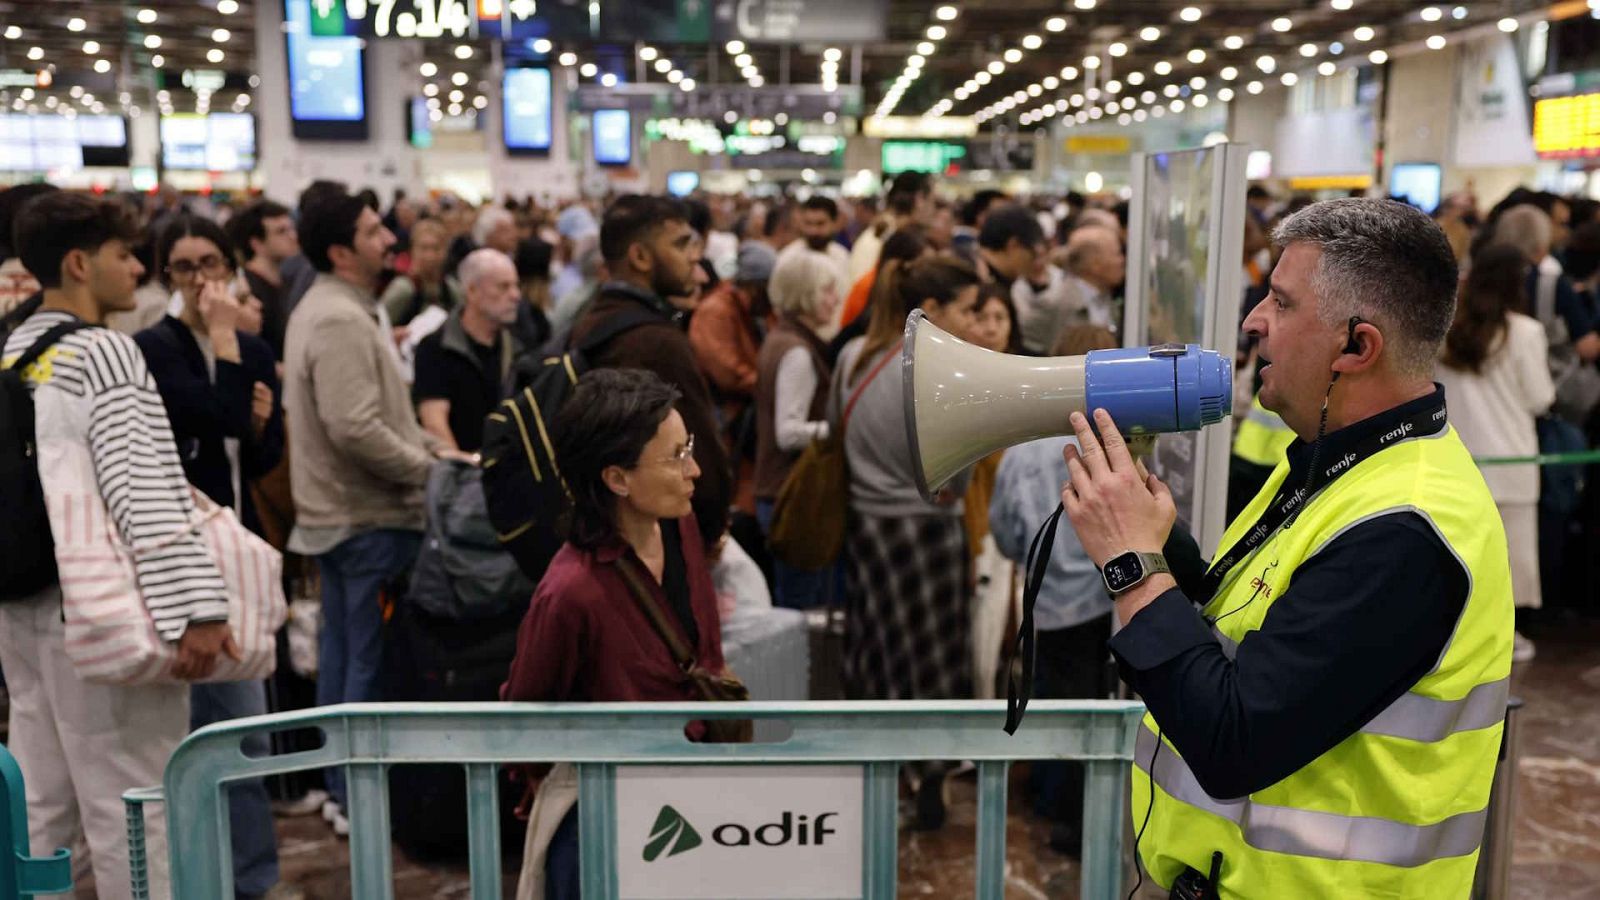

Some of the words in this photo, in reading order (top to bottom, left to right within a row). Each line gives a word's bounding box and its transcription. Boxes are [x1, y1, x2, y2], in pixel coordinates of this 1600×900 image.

[1214, 556, 1233, 577] renfe
[1245, 524, 1269, 547] renfe
[1281, 488, 1307, 513] renfe
[1325, 452, 1357, 477] renfe
[1380, 421, 1413, 444] renfe
[1432, 404, 1446, 421] renf
[712, 811, 839, 846] adif
